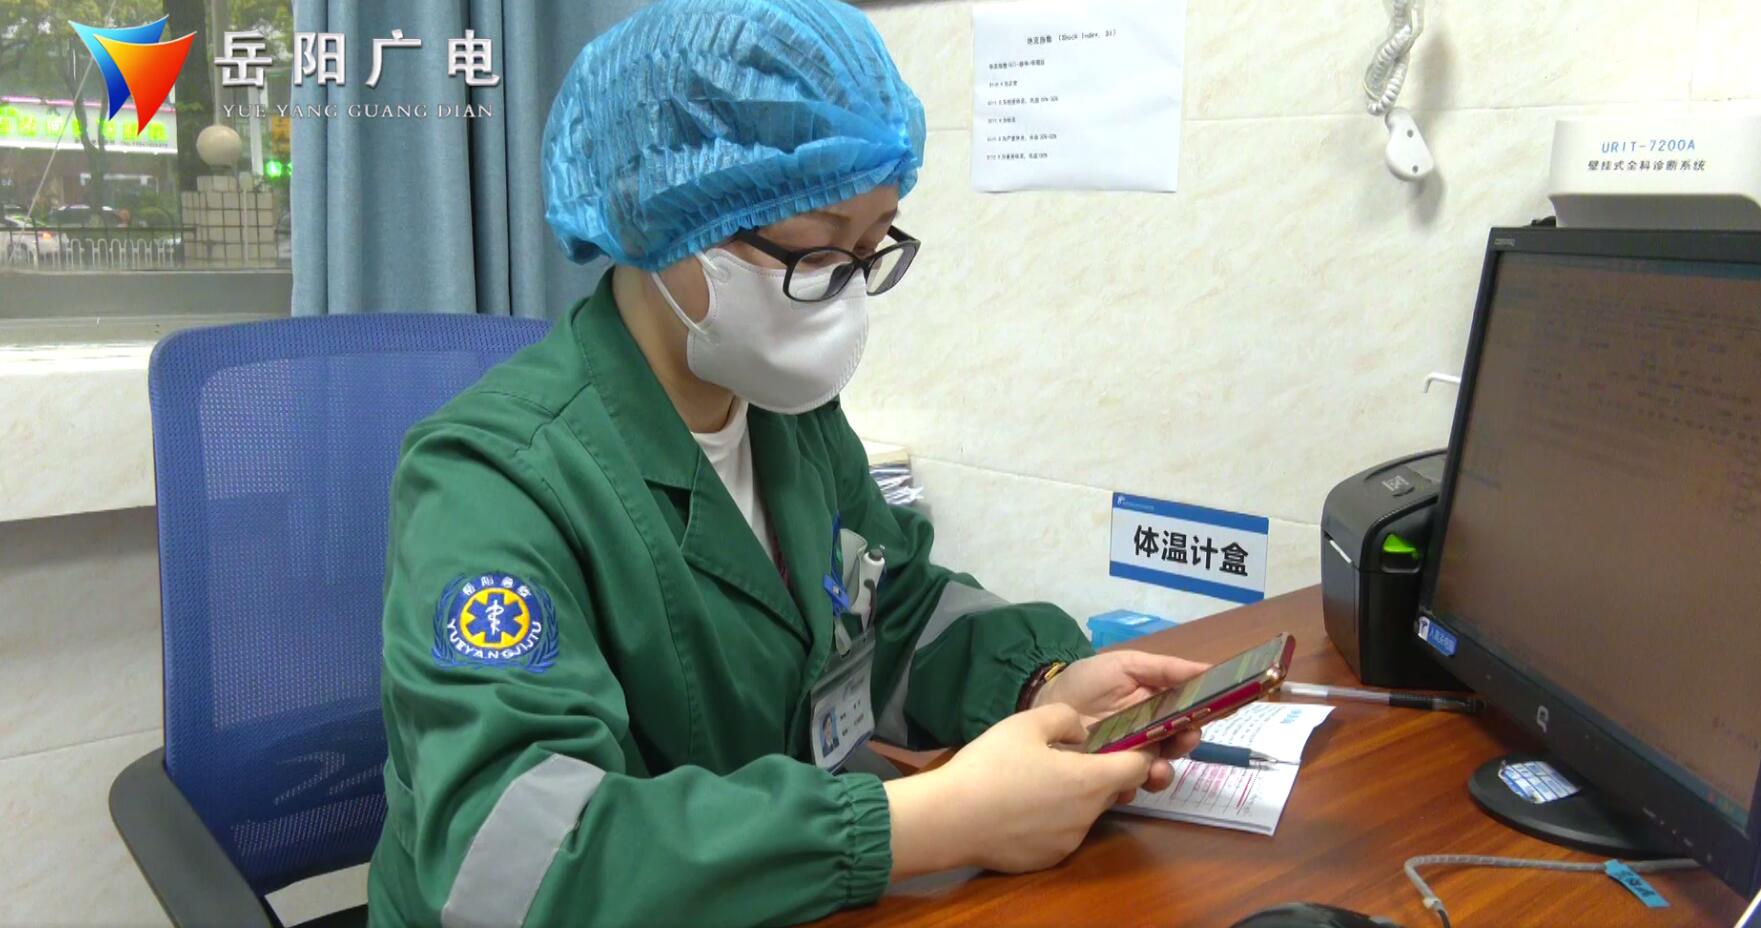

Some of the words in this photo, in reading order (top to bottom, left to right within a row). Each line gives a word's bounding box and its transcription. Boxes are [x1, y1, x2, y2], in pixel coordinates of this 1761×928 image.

[1601, 139, 1697, 155] URIT-7200A
[1588, 160, 1706, 173] 壁挂式全科诊断系统
[1134, 525, 1249, 576] 体温计盒
